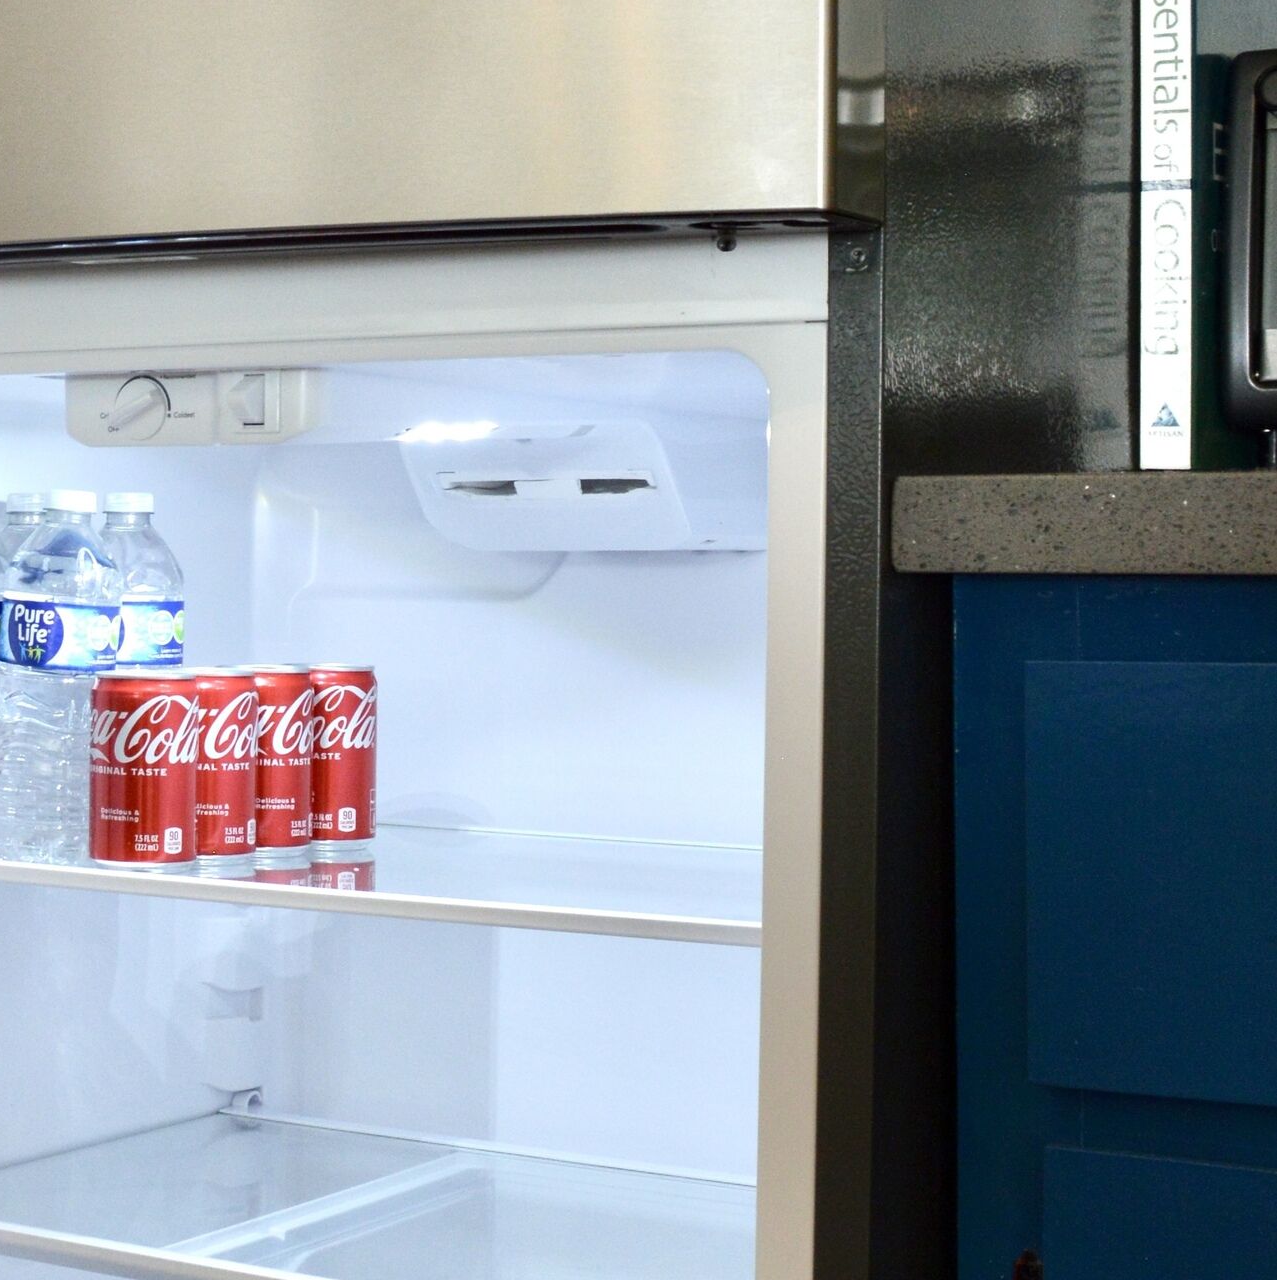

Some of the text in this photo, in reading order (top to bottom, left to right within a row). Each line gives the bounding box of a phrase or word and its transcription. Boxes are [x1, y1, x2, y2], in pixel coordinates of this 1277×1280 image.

[1152, 143, 1179, 173] of
[1144, 199, 1190, 355] Cooking
[14, 603, 56, 626] Pure
[18, 623, 49, 646] Life
[313, 752, 341, 760] ASTE
[222, 762, 250, 771] TASTE
[131, 768, 168, 777] TASTE
[100, 807, 132, 816] Delicious
[196, 809, 229, 817] freshing
[342, 810, 353, 820] 90
[100, 814, 140, 823] Refreshing
[169, 830, 179, 841] 90
